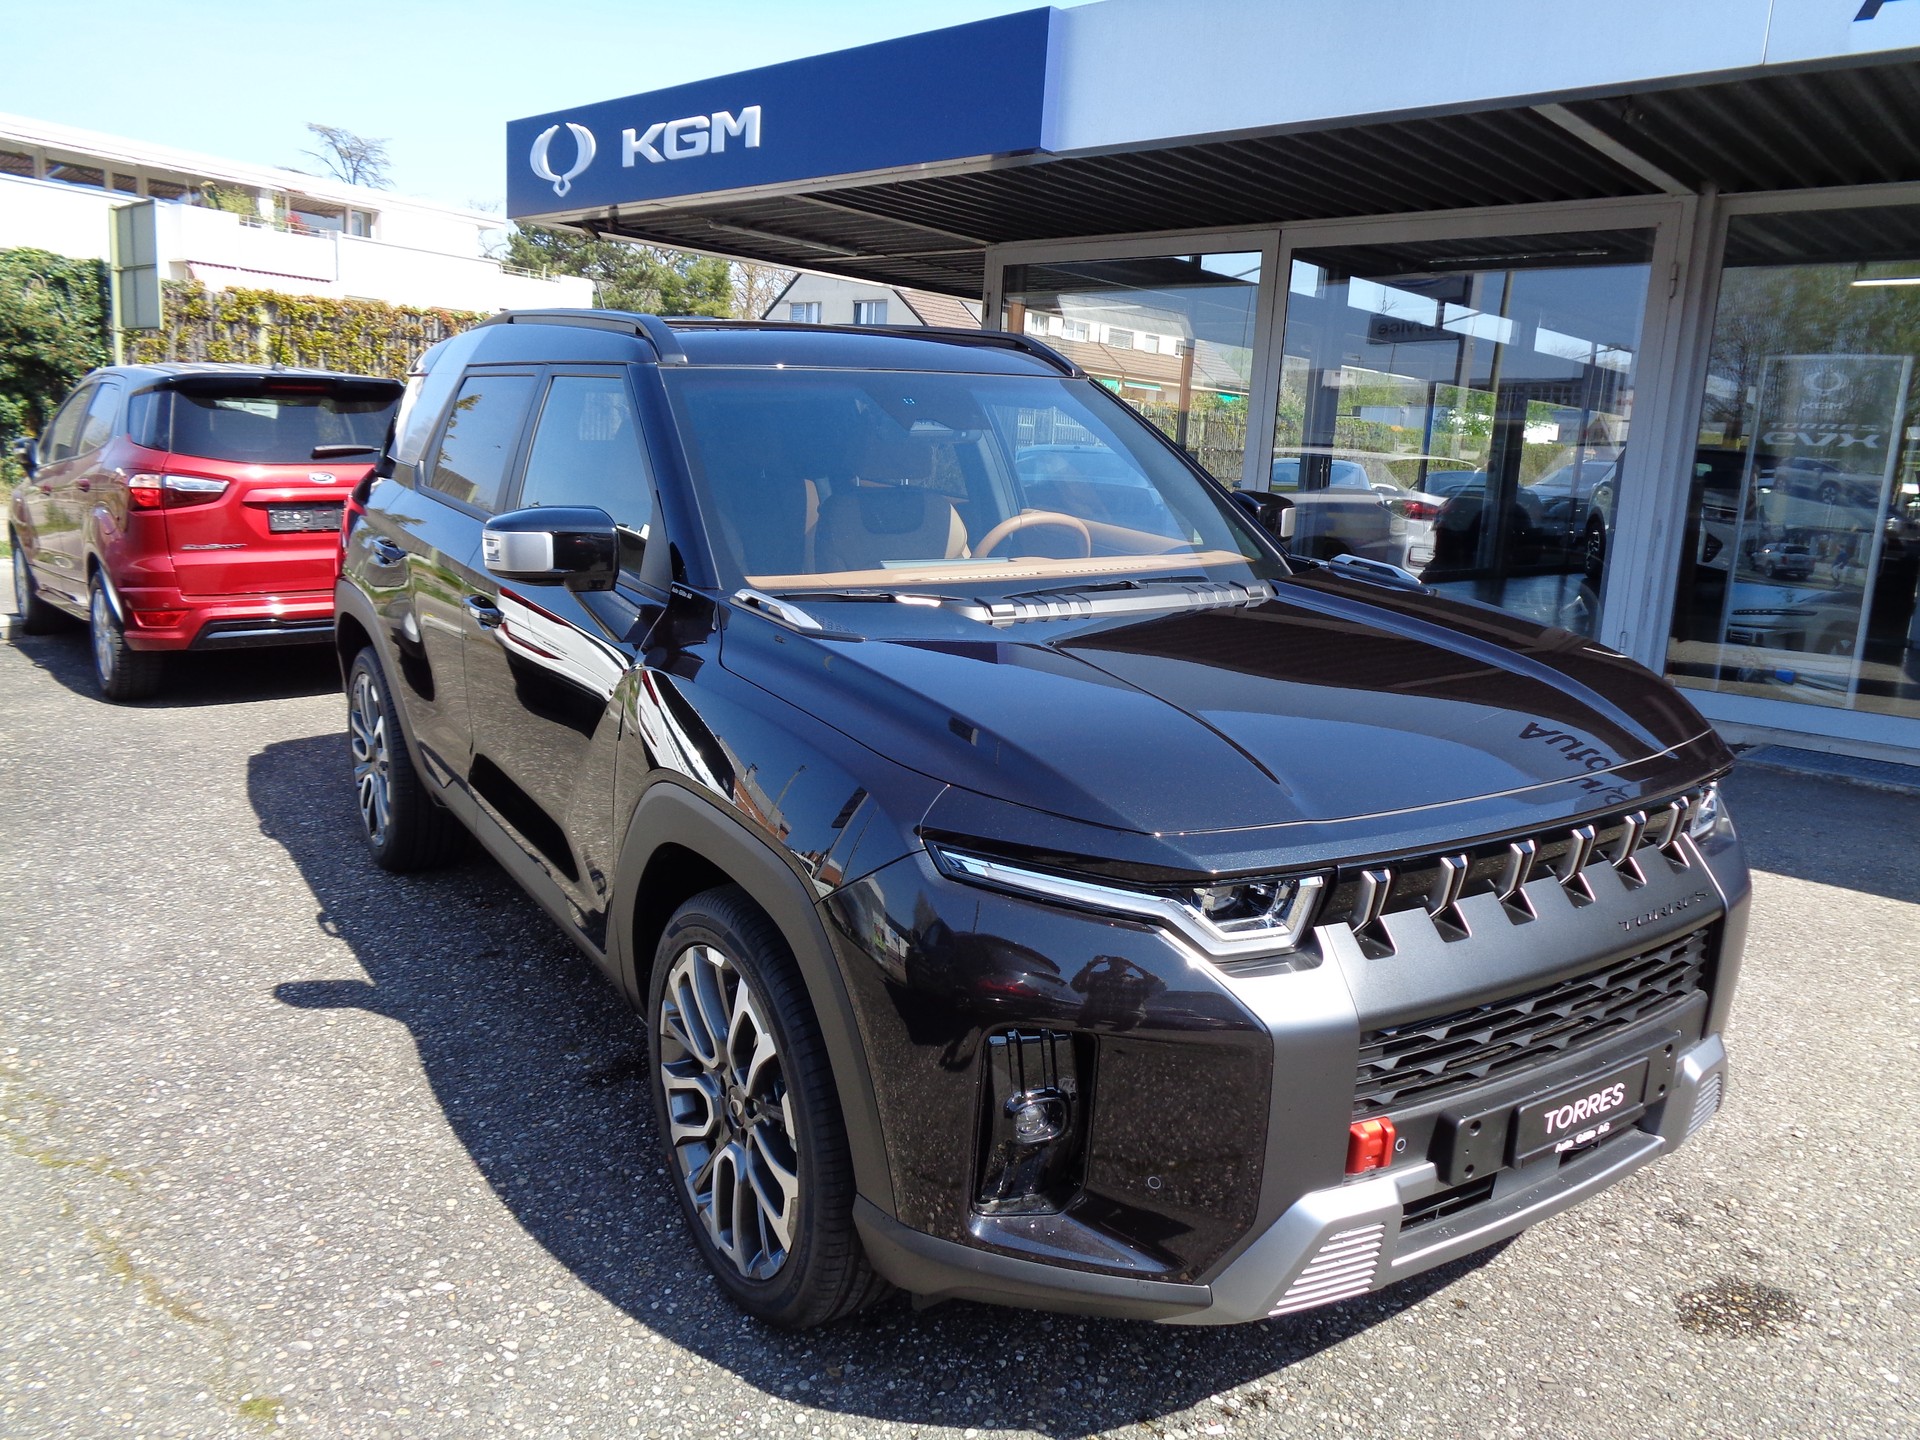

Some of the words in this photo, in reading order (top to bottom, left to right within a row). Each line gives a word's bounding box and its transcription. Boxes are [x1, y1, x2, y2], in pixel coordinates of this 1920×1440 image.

[621, 104, 761, 168] KGM
[1617, 891, 1708, 931] TORRES
[1544, 1082, 1625, 1134] TORRES
